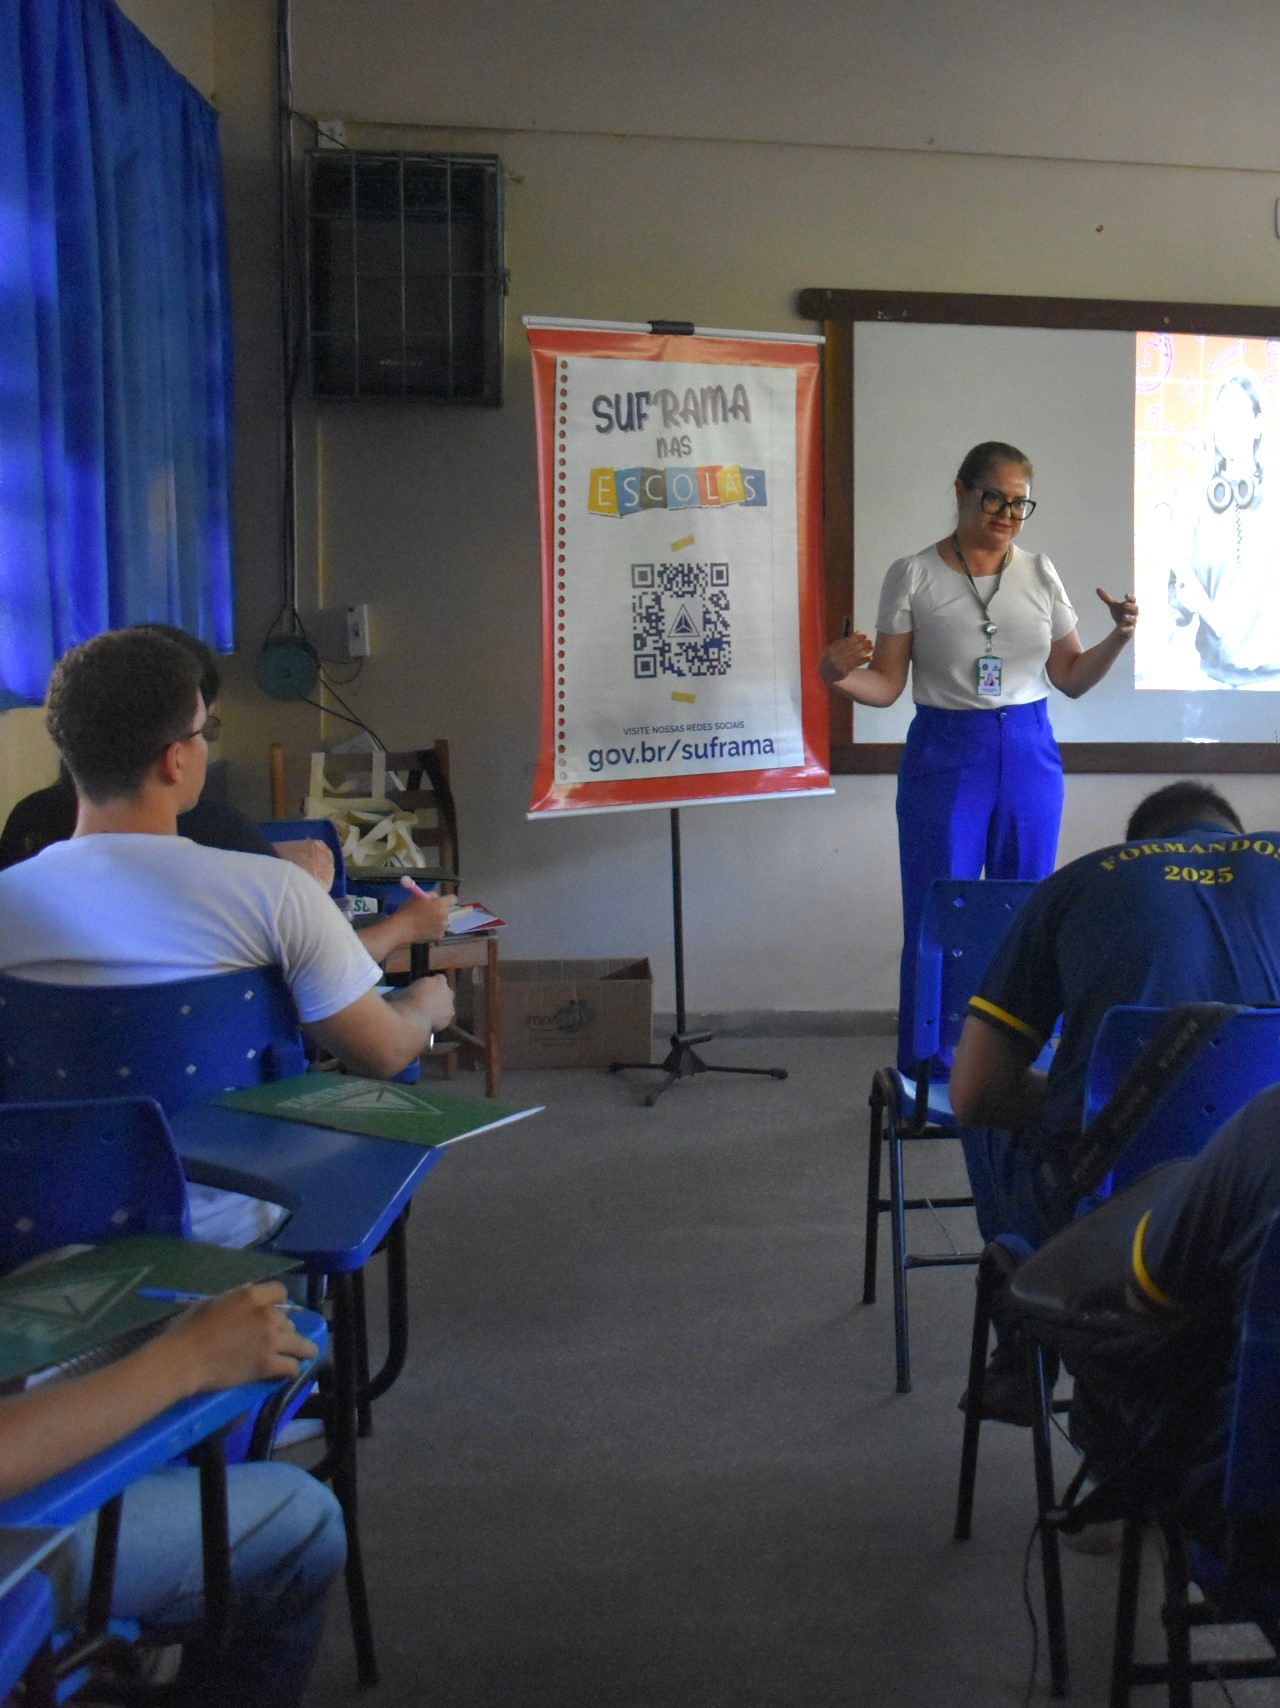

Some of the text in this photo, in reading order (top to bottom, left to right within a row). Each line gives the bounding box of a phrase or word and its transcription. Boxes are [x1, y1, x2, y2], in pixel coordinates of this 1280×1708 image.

[591, 383, 752, 434] SUFRAMA
[656, 434, 693, 459] NAS
[596, 471, 758, 508] ESCOLAS
[623, 721, 745, 736] VISITE NOSSAS REDES SOCIAIS
[588, 736, 775, 772] gov.br/suframa
[1164, 865, 1234, 886] 2025
